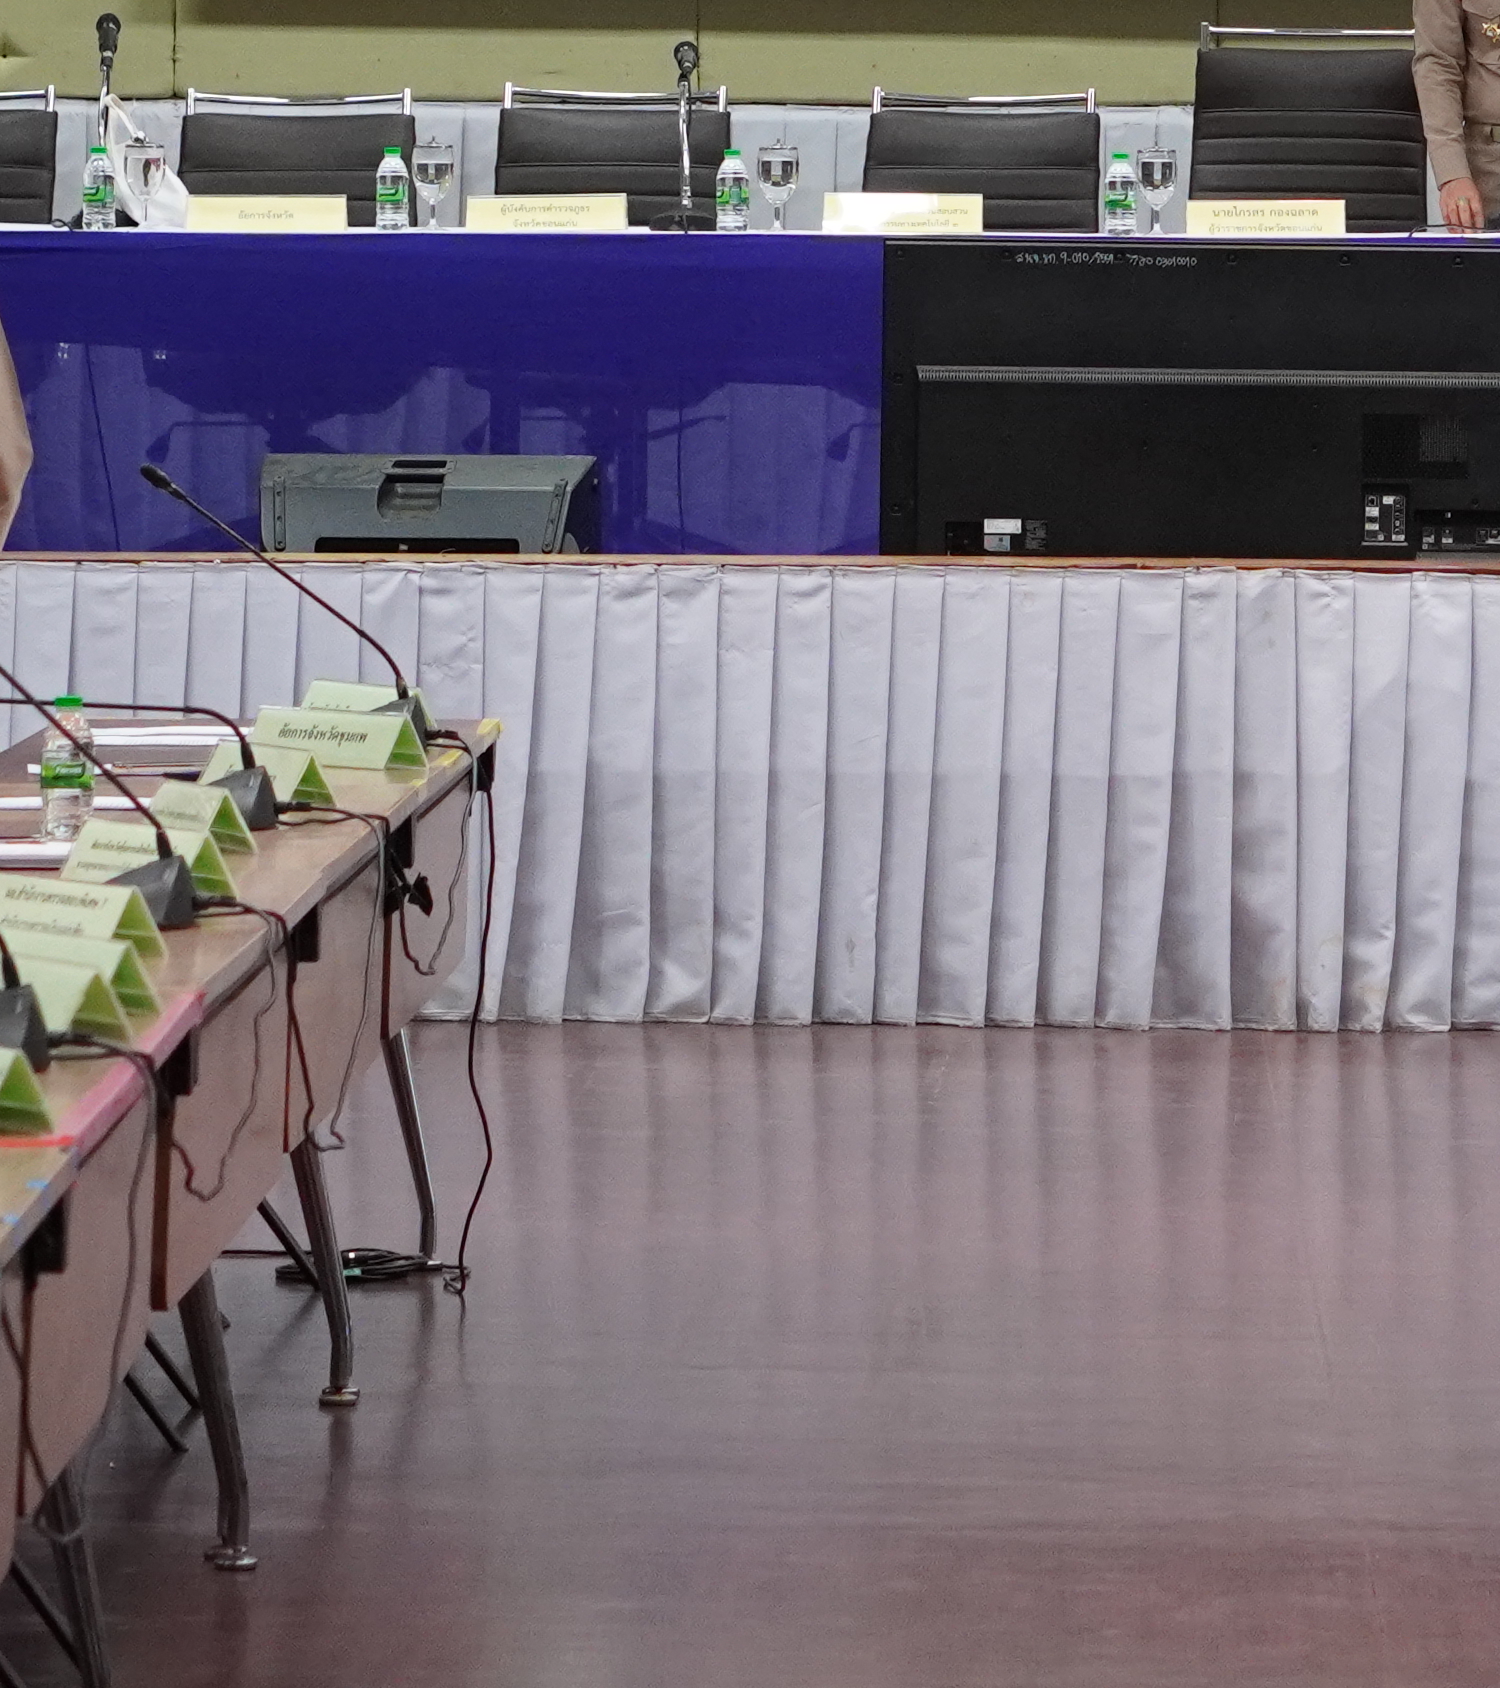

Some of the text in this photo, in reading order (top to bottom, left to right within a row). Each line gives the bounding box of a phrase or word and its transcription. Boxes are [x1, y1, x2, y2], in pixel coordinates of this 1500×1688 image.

[237, 209, 294, 220] อัยการจังหวัด
